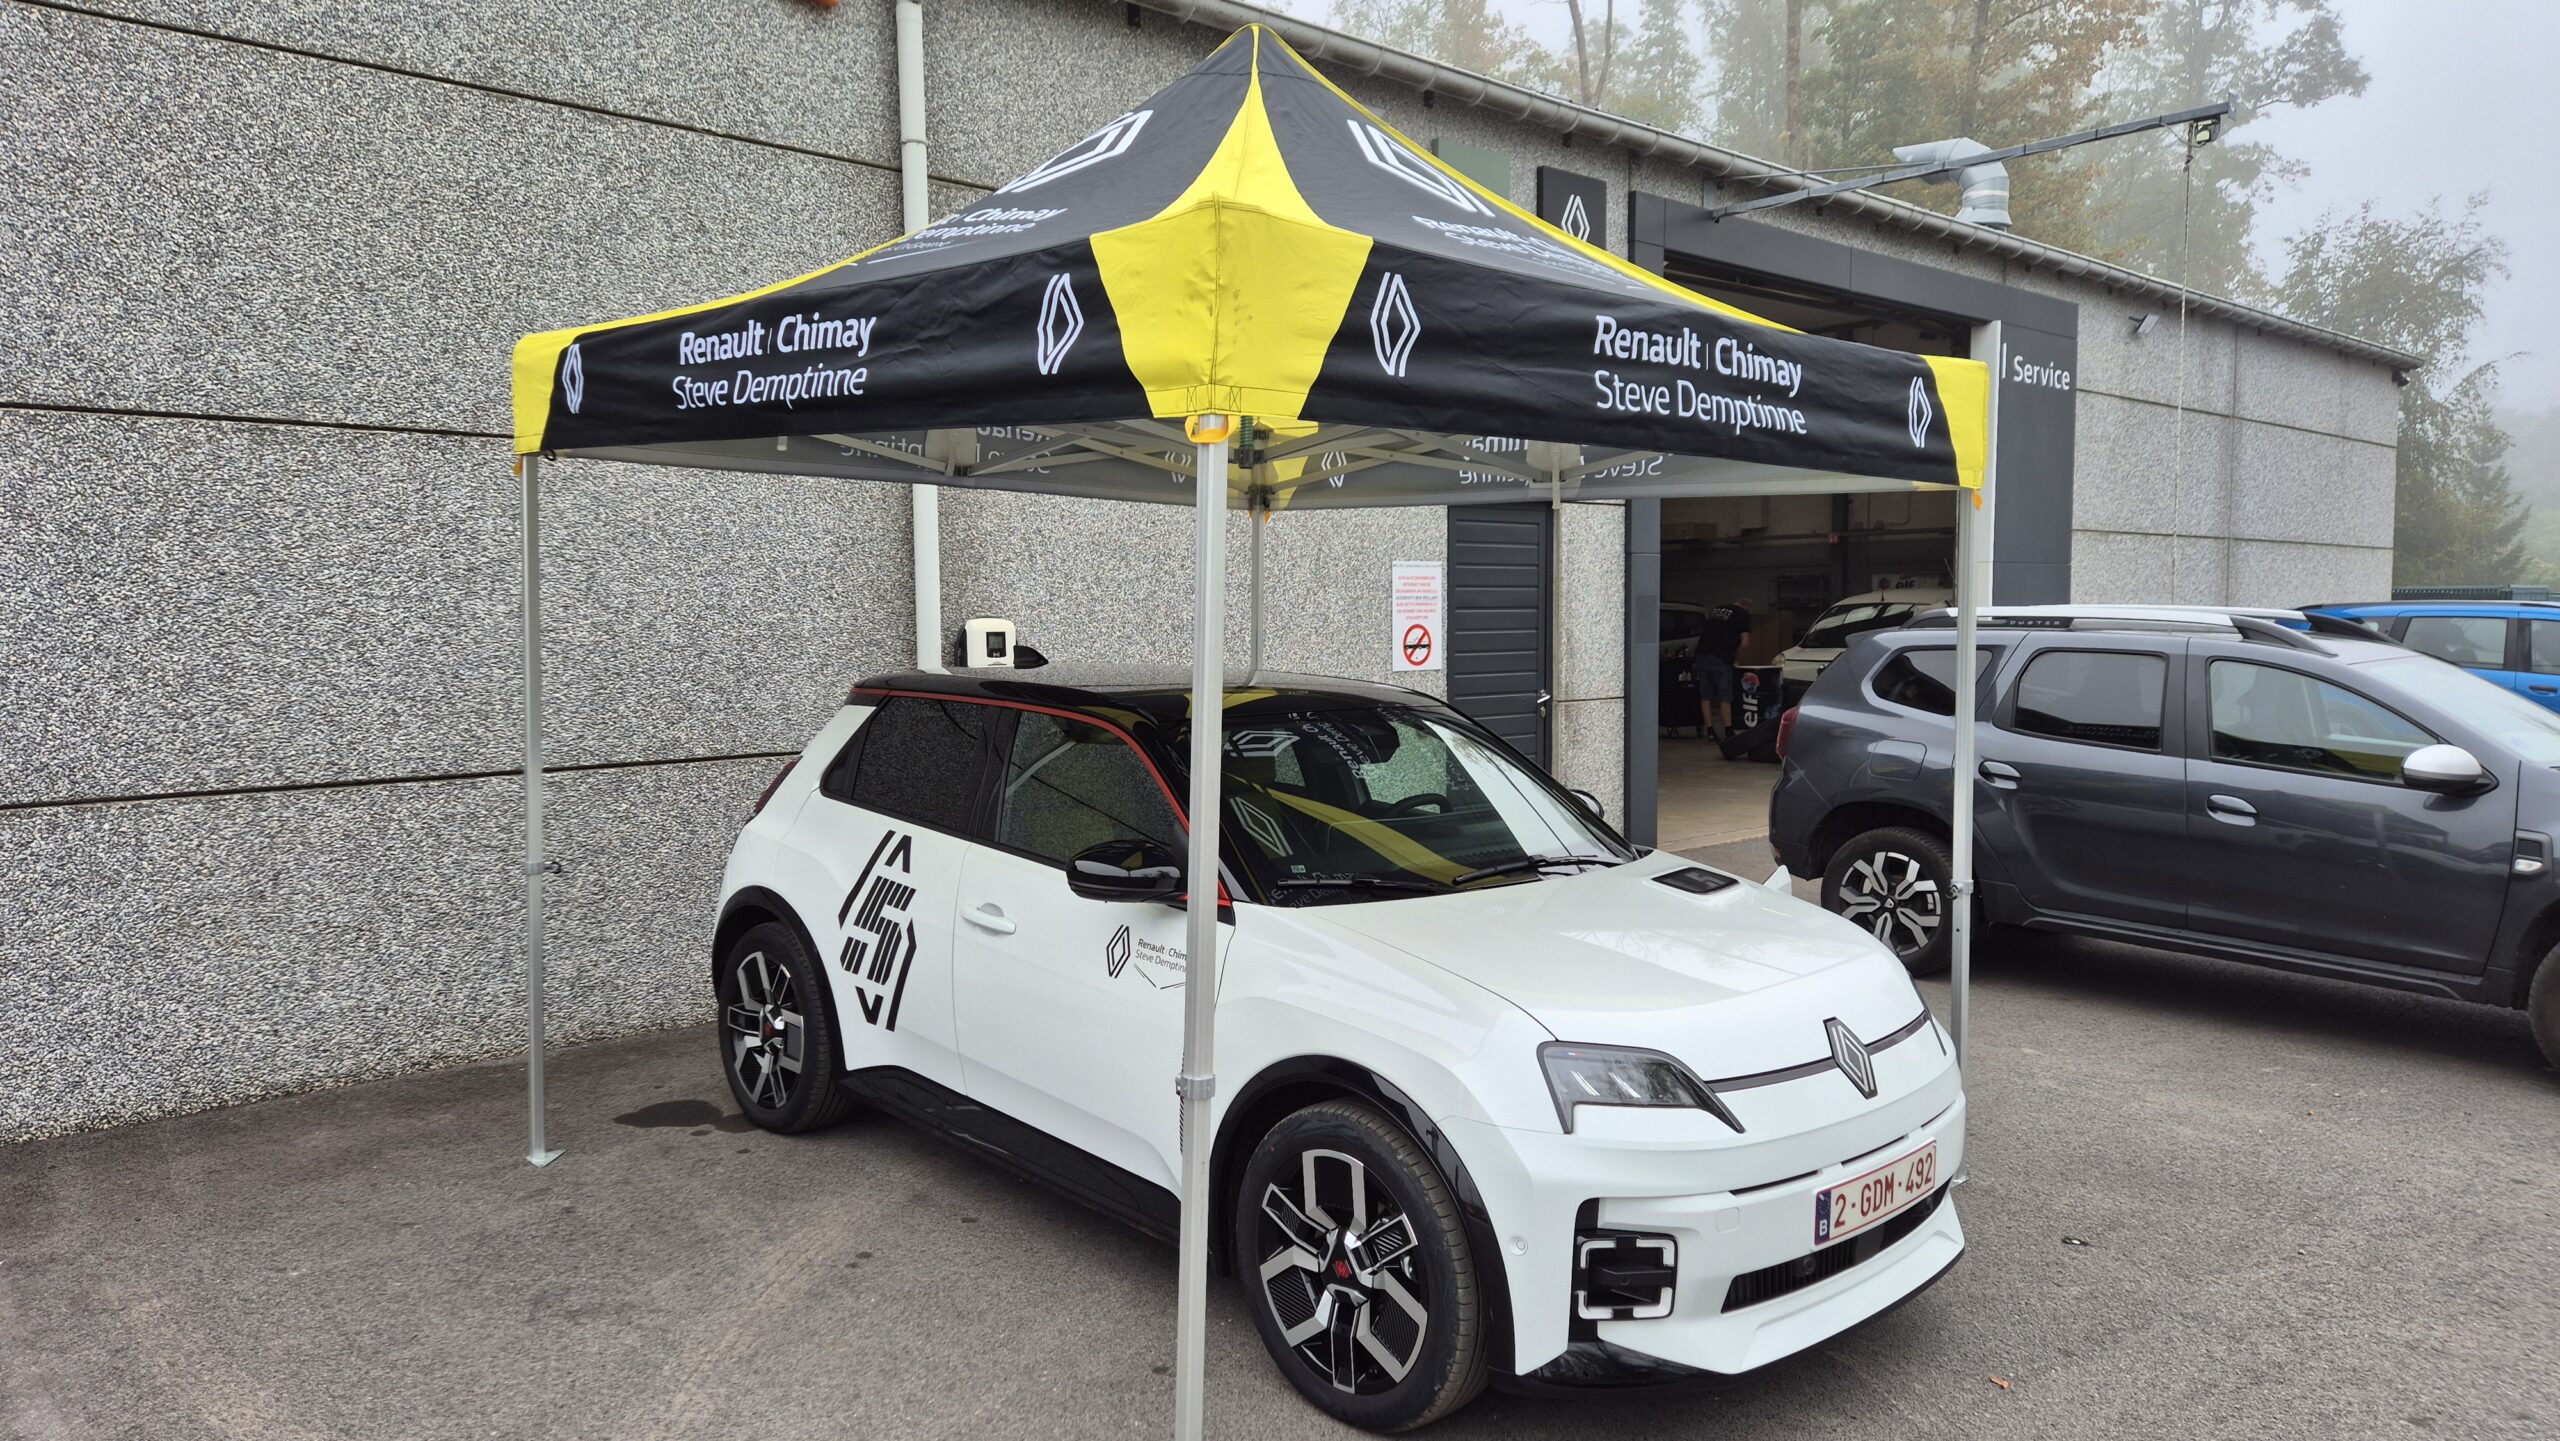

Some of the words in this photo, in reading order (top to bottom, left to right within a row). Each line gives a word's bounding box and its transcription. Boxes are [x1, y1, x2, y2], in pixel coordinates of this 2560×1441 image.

[679, 319, 765, 365] Renault
[776, 311, 877, 357] Chimay
[1594, 314, 1701, 369] Renault
[1714, 336, 1802, 398] Chimay
[672, 375, 728, 410] Steve
[732, 362, 867, 410] Demptinne
[2013, 354, 2071, 391] Service
[1594, 369, 1670, 415] Steve
[1676, 379, 1808, 436] Demptinne
[1742, 692, 1758, 728] elf
[1135, 949, 1154, 963] Steve
[1154, 955, 1187, 973] Demptin
[1138, 938, 1165, 955] Renault
[1168, 947, 1187, 961] Chim
[1819, 1219, 1828, 1236] B
